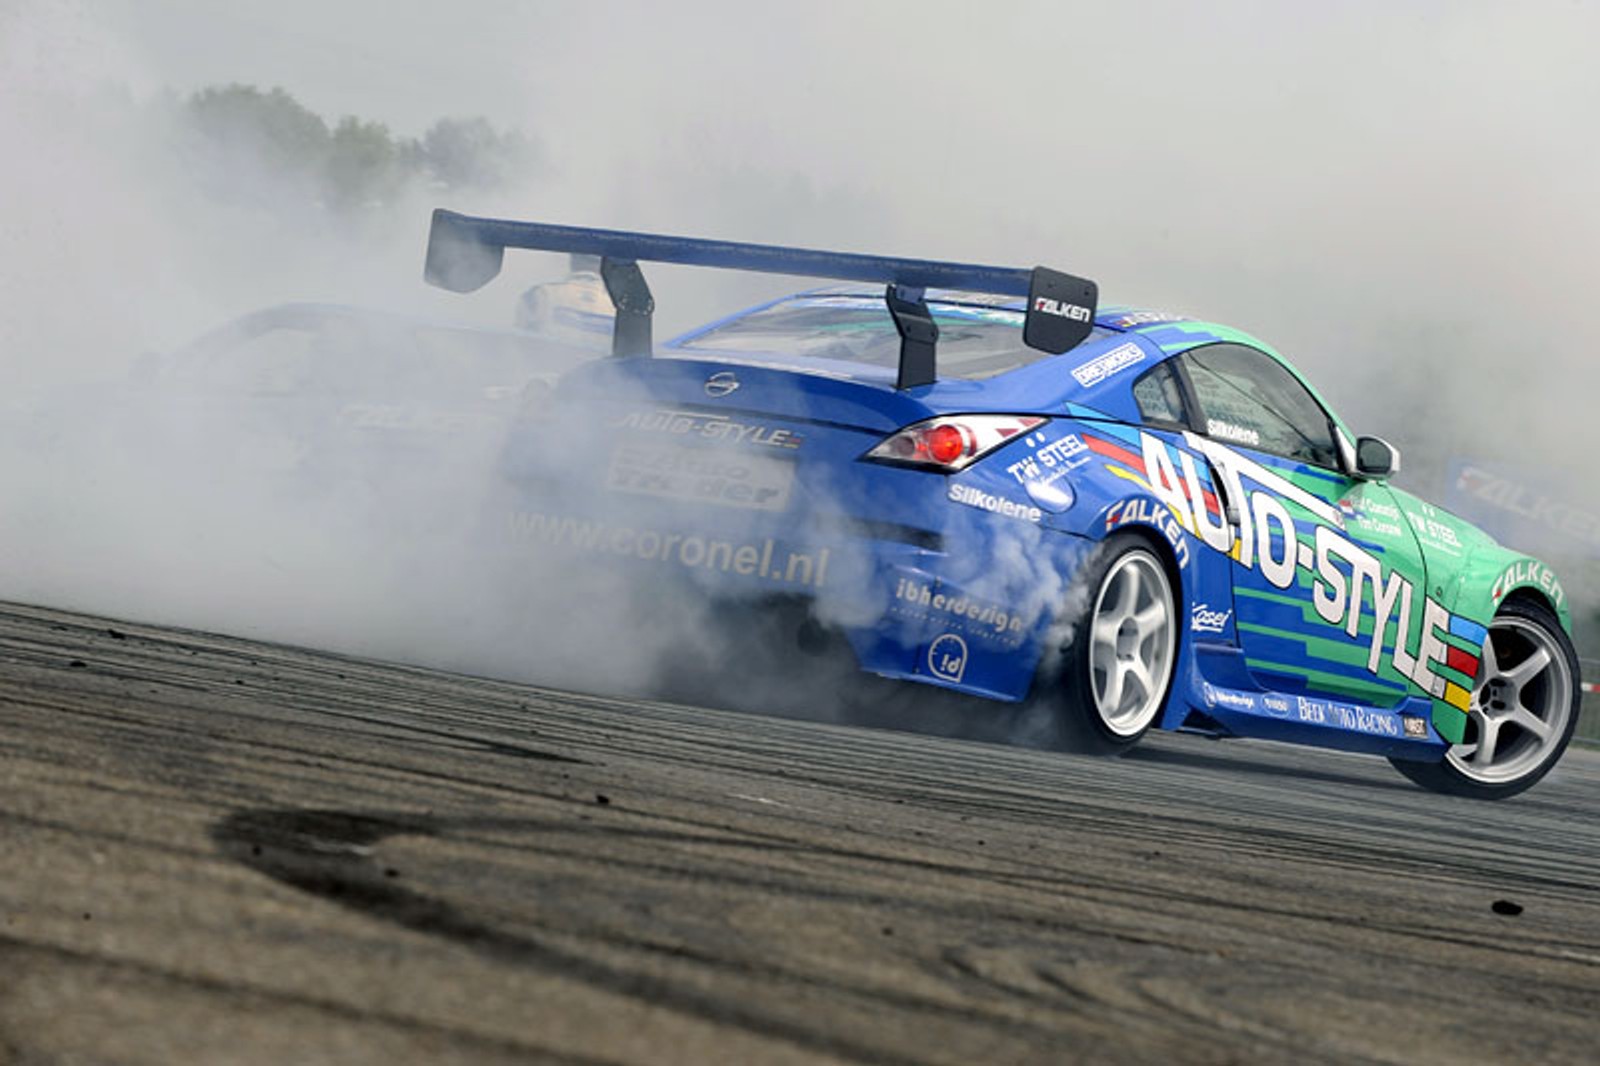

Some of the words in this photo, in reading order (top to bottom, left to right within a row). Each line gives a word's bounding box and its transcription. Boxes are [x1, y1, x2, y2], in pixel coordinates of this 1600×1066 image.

[1034, 297, 1092, 323] FALKEN
[1006, 456, 1041, 484] TW
[1036, 434, 1089, 467] STEEL
[949, 483, 1042, 521] Silkolene
[508, 511, 830, 588] www.coronel.nl
[1105, 499, 1190, 570] FALKEN
[1140, 430, 1450, 700] AUTO-STYLE
[1491, 561, 1564, 607] FALKEN
